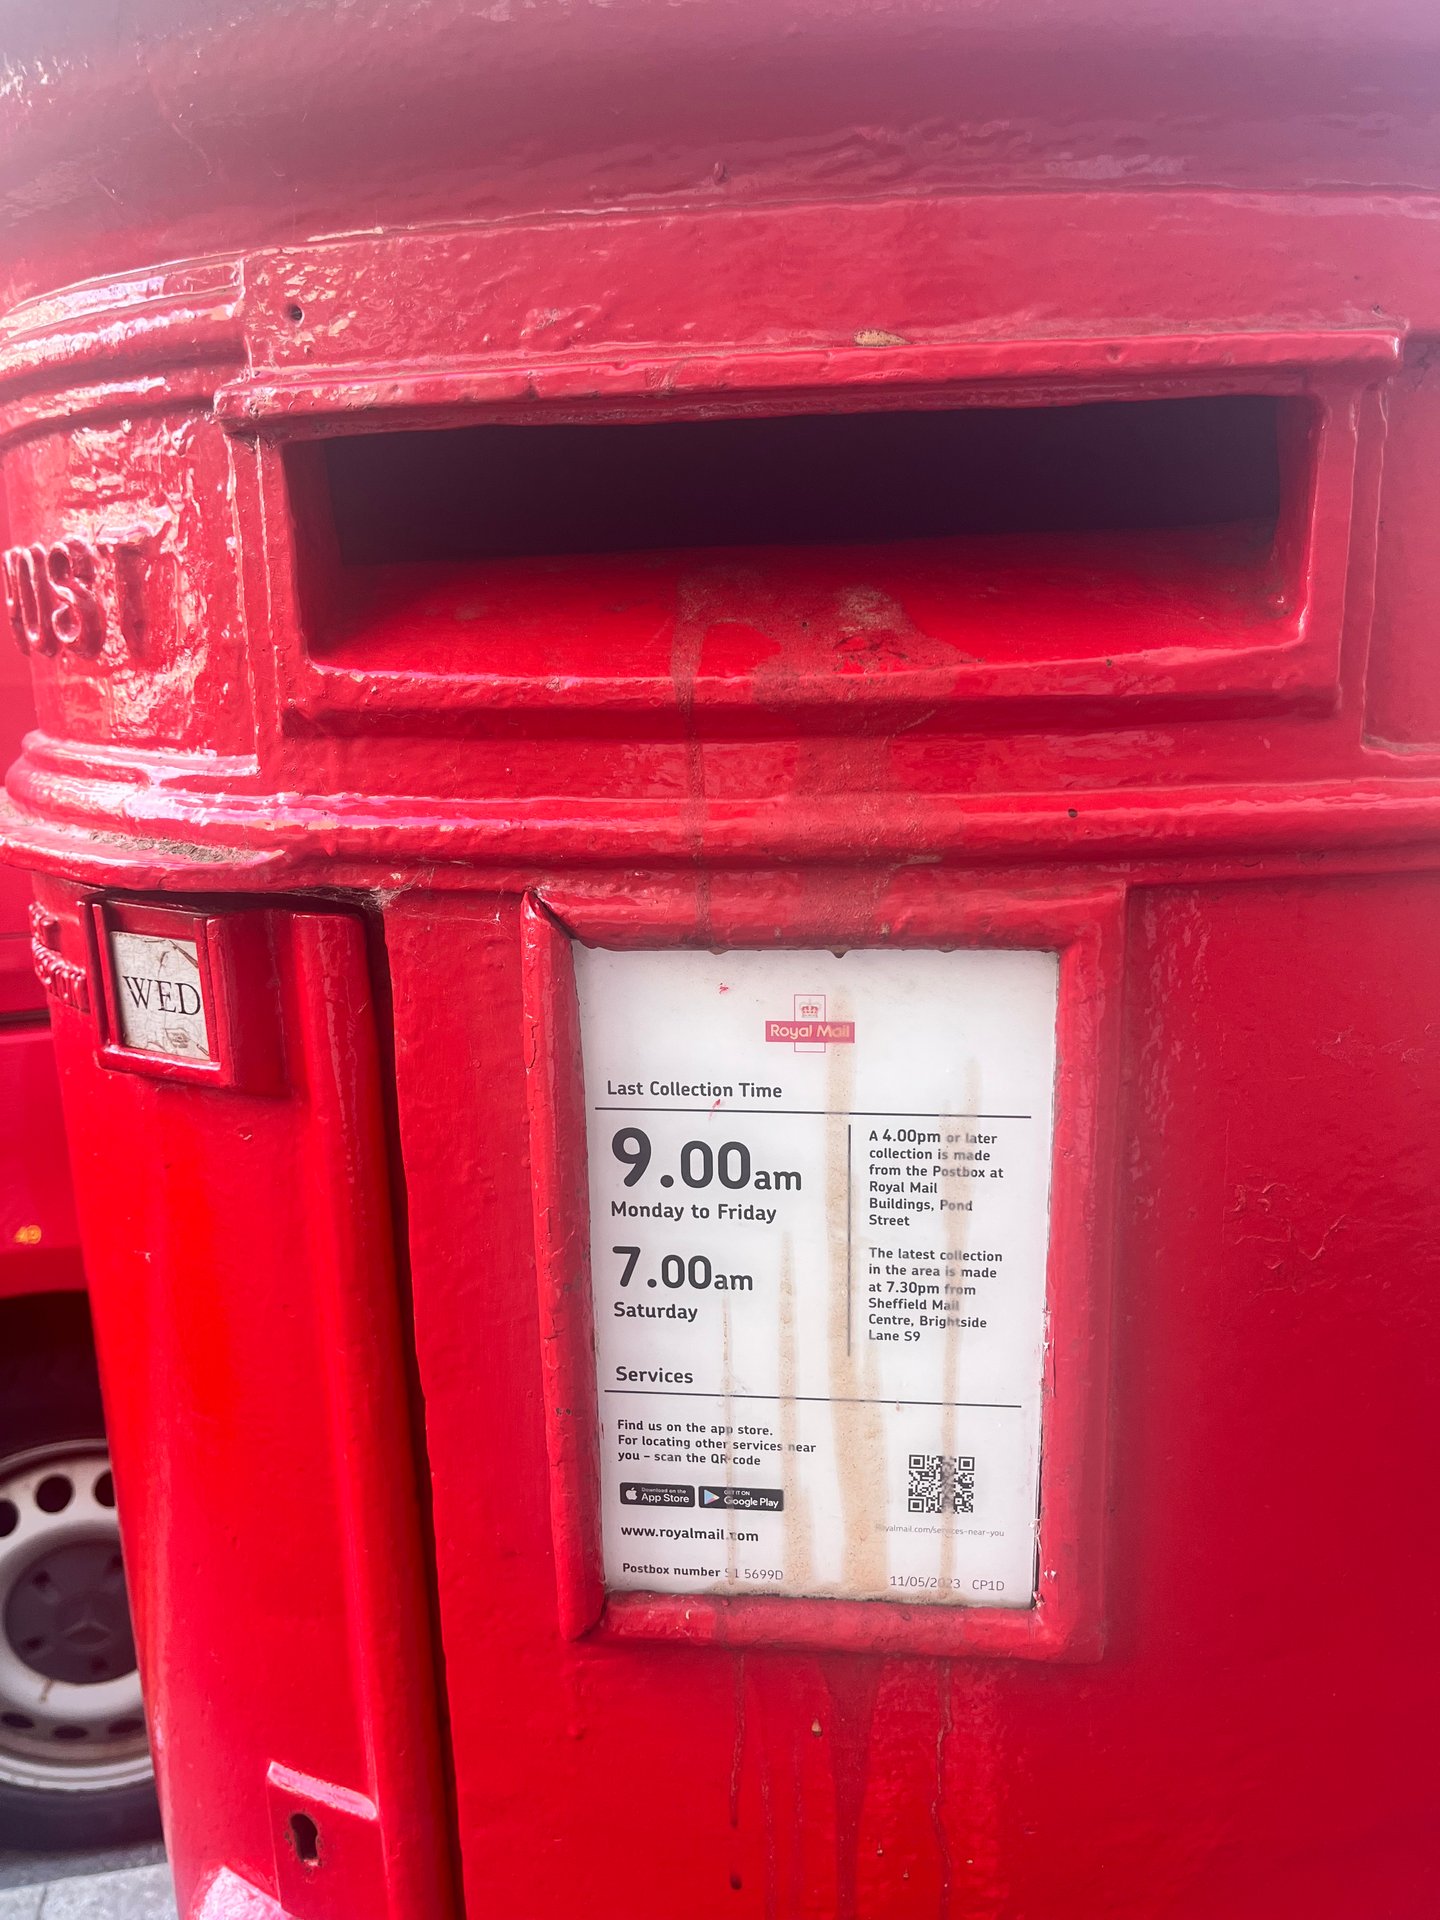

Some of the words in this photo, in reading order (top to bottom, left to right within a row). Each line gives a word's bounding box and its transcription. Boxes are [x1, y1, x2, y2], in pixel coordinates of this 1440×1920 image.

[122, 975, 201, 1015] WED
[770, 1023, 813, 1040] Royal
[816, 1024, 850, 1038] Mail
[607, 1080, 644, 1096] Last
[649, 1080, 733, 1097] Collection
[738, 1082, 783, 1098] Time
[869, 1130, 878, 1141] A
[882, 1128, 941, 1145] 4.00pm
[946, 1134, 960, 1143] or
[965, 1132, 998, 1144] later
[611, 1126, 802, 1191] 9.00am
[869, 1148, 933, 1160] collection
[937, 1148, 949, 1160] is
[953, 1149, 991, 1161] made
[869, 1164, 901, 1175] from
[906, 1165, 928, 1176] the
[933, 1165, 986, 1178] Postbox
[990, 1168, 1004, 1178] at
[869, 1181, 905, 1194] Royal
[910, 1181, 938, 1193] Mail
[611, 1200, 684, 1222] Monday
[690, 1203, 710, 1219] to
[717, 1203, 777, 1224] Friday
[869, 1197, 935, 1212] Buildings,
[940, 1199, 973, 1211] Pond
[869, 1214, 910, 1226] Street
[868, 1247, 894, 1259] The
[898, 1248, 936, 1260] latest
[939, 1249, 1003, 1262] collection
[612, 1245, 753, 1291] 7.00am
[868, 1264, 881, 1275] in
[885, 1264, 907, 1276] the
[911, 1267, 940, 1276] area
[945, 1265, 956, 1277] is
[961, 1267, 997, 1278] made
[868, 1282, 882, 1292] at
[886, 1281, 940, 1296] 7.30pm
[944, 1284, 976, 1295] from
[613, 1301, 698, 1322] Saturday
[868, 1297, 927, 1310] Sheffield
[932, 1299, 960, 1311] Mail
[868, 1313, 915, 1327] Centre,
[919, 1315, 988, 1329] Brightside
[868, 1329, 900, 1341] Lane
[904, 1330, 921, 1341] S9
[615, 1366, 694, 1384] Services
[617, 1419, 643, 1431] Find
[648, 1421, 662, 1431] us
[666, 1423, 682, 1432] on
[686, 1422, 706, 1433] the
[710, 1424, 733, 1437] app
[737, 1425, 773, 1436] store.
[618, 1435, 638, 1446] For
[641, 1435, 691, 1449] locating
[695, 1437, 727, 1449] other
[732, 1439, 783, 1451] services
[787, 1444, 817, 1453] near
[618, 1452, 640, 1462] you
[654, 1453, 682, 1462] scan
[686, 1452, 706, 1463] the
[710, 1453, 728, 1465] QR
[732, 1455, 761, 1466] code
[641, 1492, 662, 1503] App
[663, 1493, 690, 1503] Store
[723, 1495, 758, 1508] Google
[759, 1497, 779, 1509] Play
[622, 1563, 670, 1575] Postbox
[673, 1565, 721, 1577] number
[744, 1569, 784, 1581] 5699D
[972, 1579, 1005, 1591] CP1D
